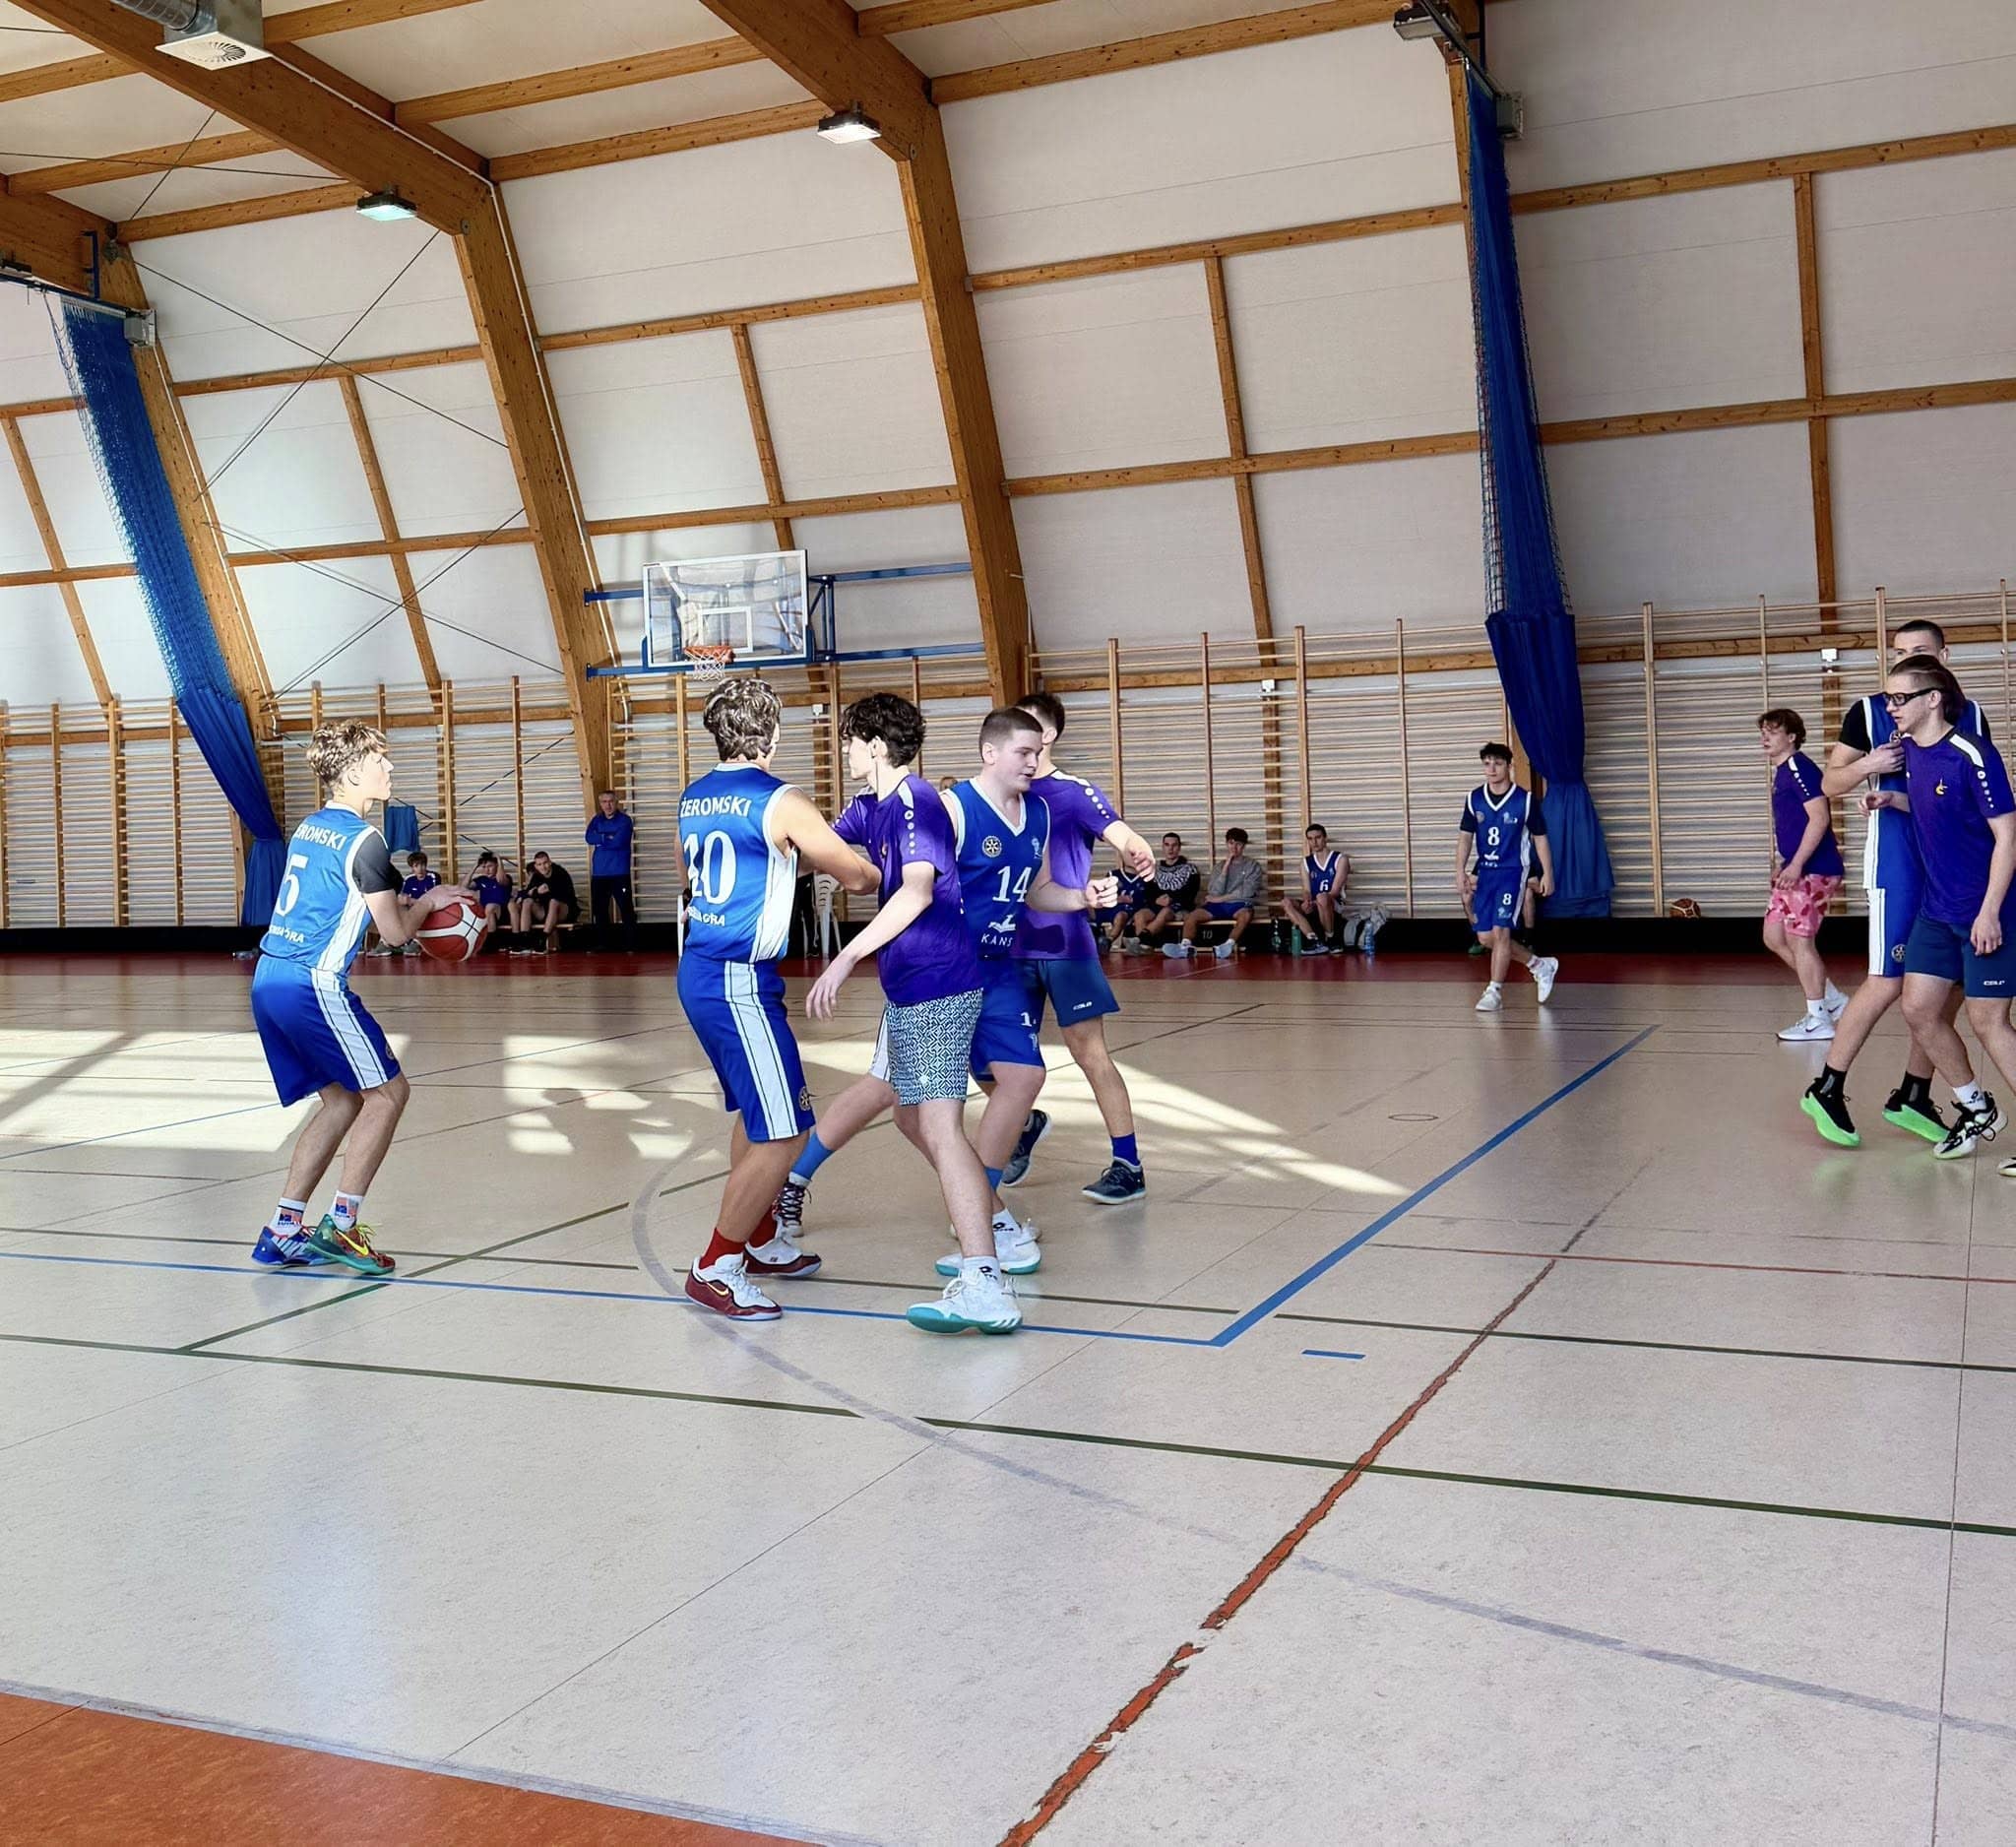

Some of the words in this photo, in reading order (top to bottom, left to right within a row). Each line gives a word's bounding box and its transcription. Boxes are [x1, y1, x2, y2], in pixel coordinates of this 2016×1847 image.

[680, 795, 752, 818] ŻEROMSKI
[1487, 826, 1500, 846] 8
[276, 854, 309, 917] 5
[992, 865, 1033, 903] 14
[1502, 893, 1512, 905] 8
[981, 932, 1014, 947] KANS
